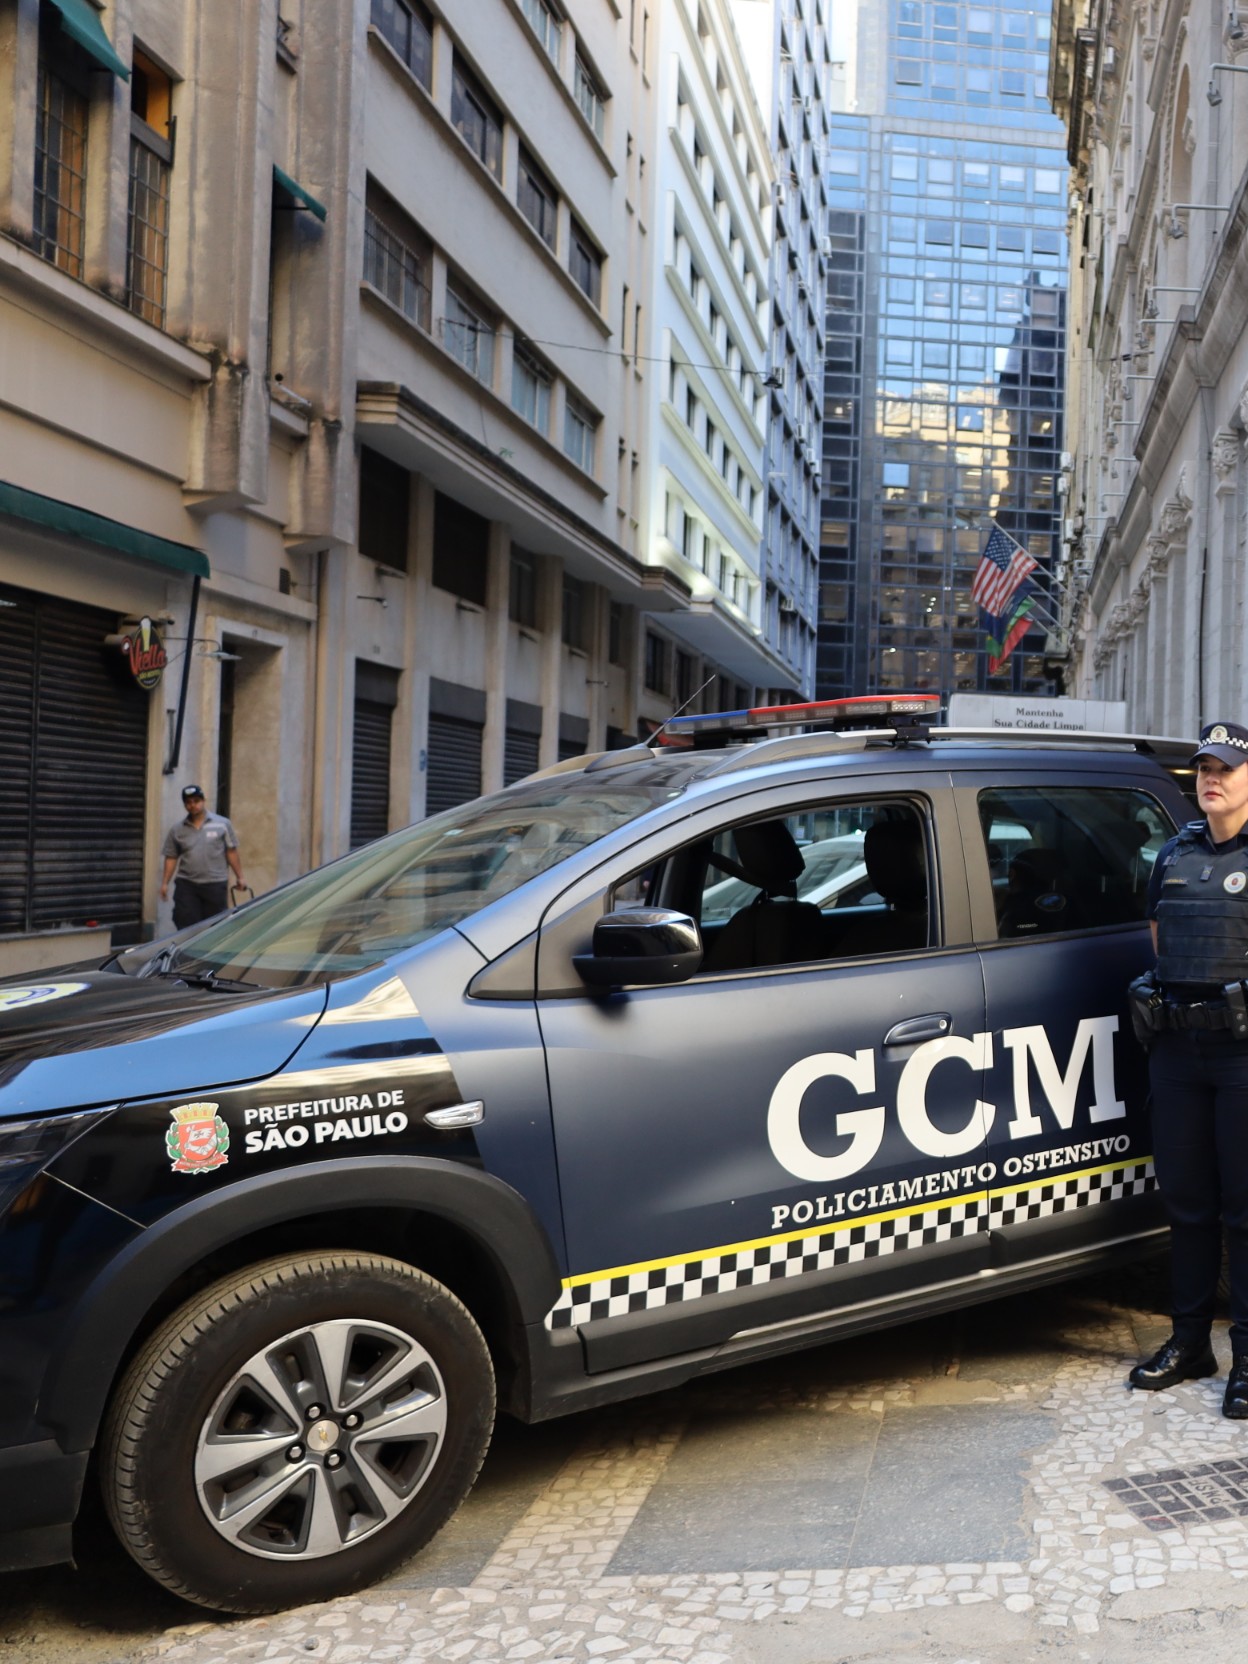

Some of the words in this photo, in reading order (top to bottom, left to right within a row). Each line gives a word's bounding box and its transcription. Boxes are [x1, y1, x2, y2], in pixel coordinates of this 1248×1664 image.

[994, 719, 1013, 728] Sua
[1016, 720, 1051, 729] Cidade
[1053, 721, 1084, 731] Limpa
[1016, 708, 1064, 718] Mantenha
[244, 1094, 373, 1125] PREFEITURA
[377, 1090, 404, 1107] DE
[767, 1014, 1127, 1183] GCM
[245, 1122, 309, 1153] SÃO
[315, 1111, 408, 1144] PAULO
[771, 1162, 997, 1229] POLICIAMENTO
[1003, 1134, 1131, 1177] OSTENSIVO
